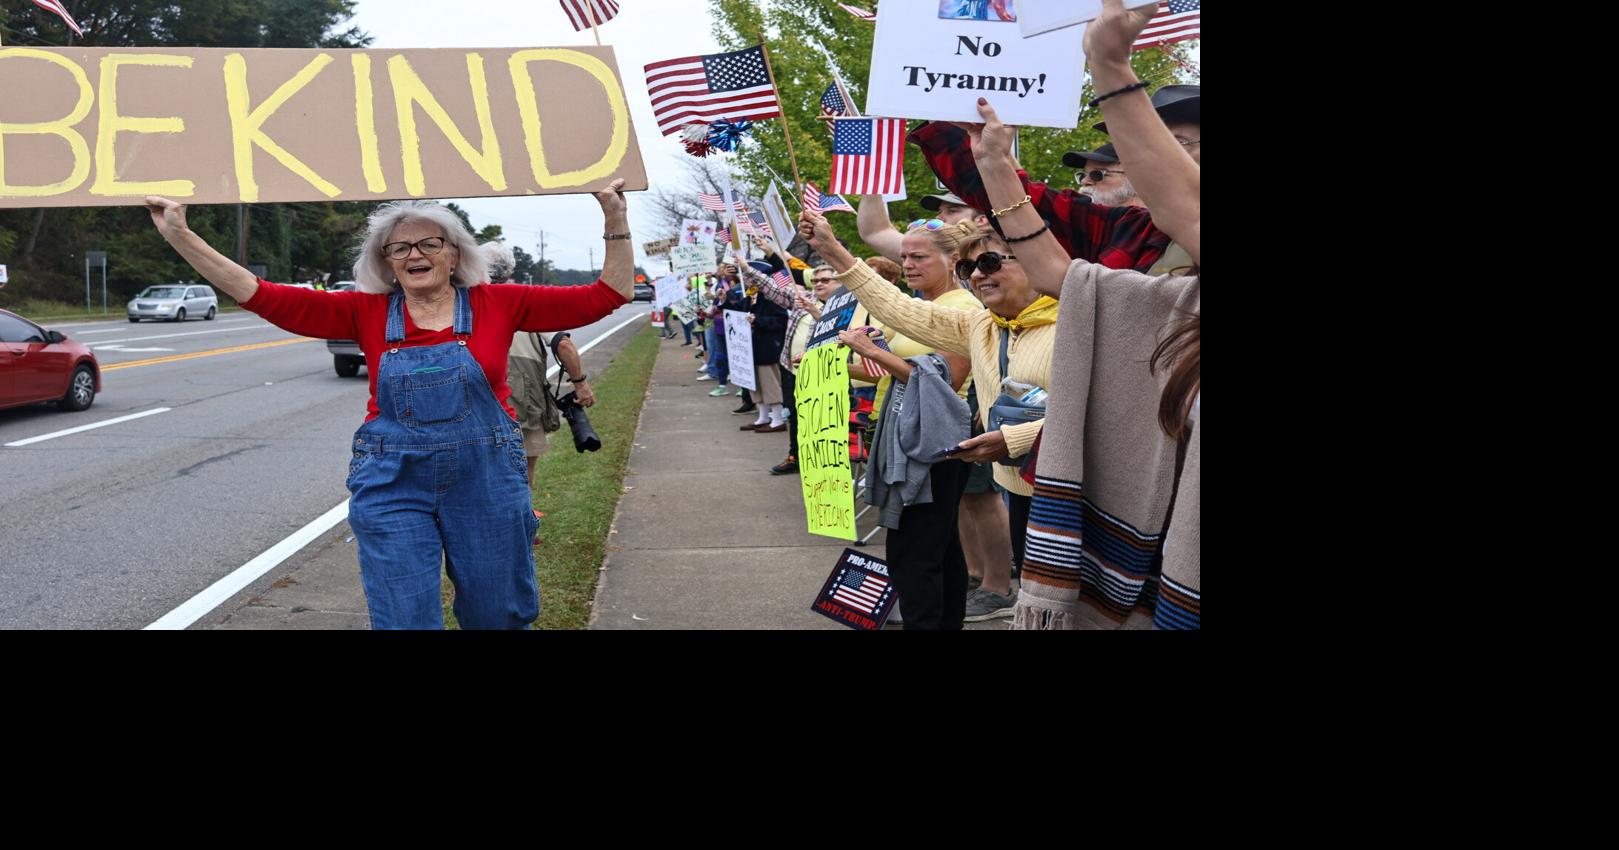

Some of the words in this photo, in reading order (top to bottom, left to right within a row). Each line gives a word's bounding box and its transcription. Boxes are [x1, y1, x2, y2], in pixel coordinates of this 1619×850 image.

[954, 35, 1001, 58] No
[903, 66, 1047, 98] Tyranny!
[0, 47, 195, 198] BE
[223, 48, 630, 202] KIND
[817, 346, 841, 388] MORE
[797, 391, 844, 438] STOLEN
[800, 438, 850, 473] FAMILIES
[846, 553, 890, 576] PRO-AMER
